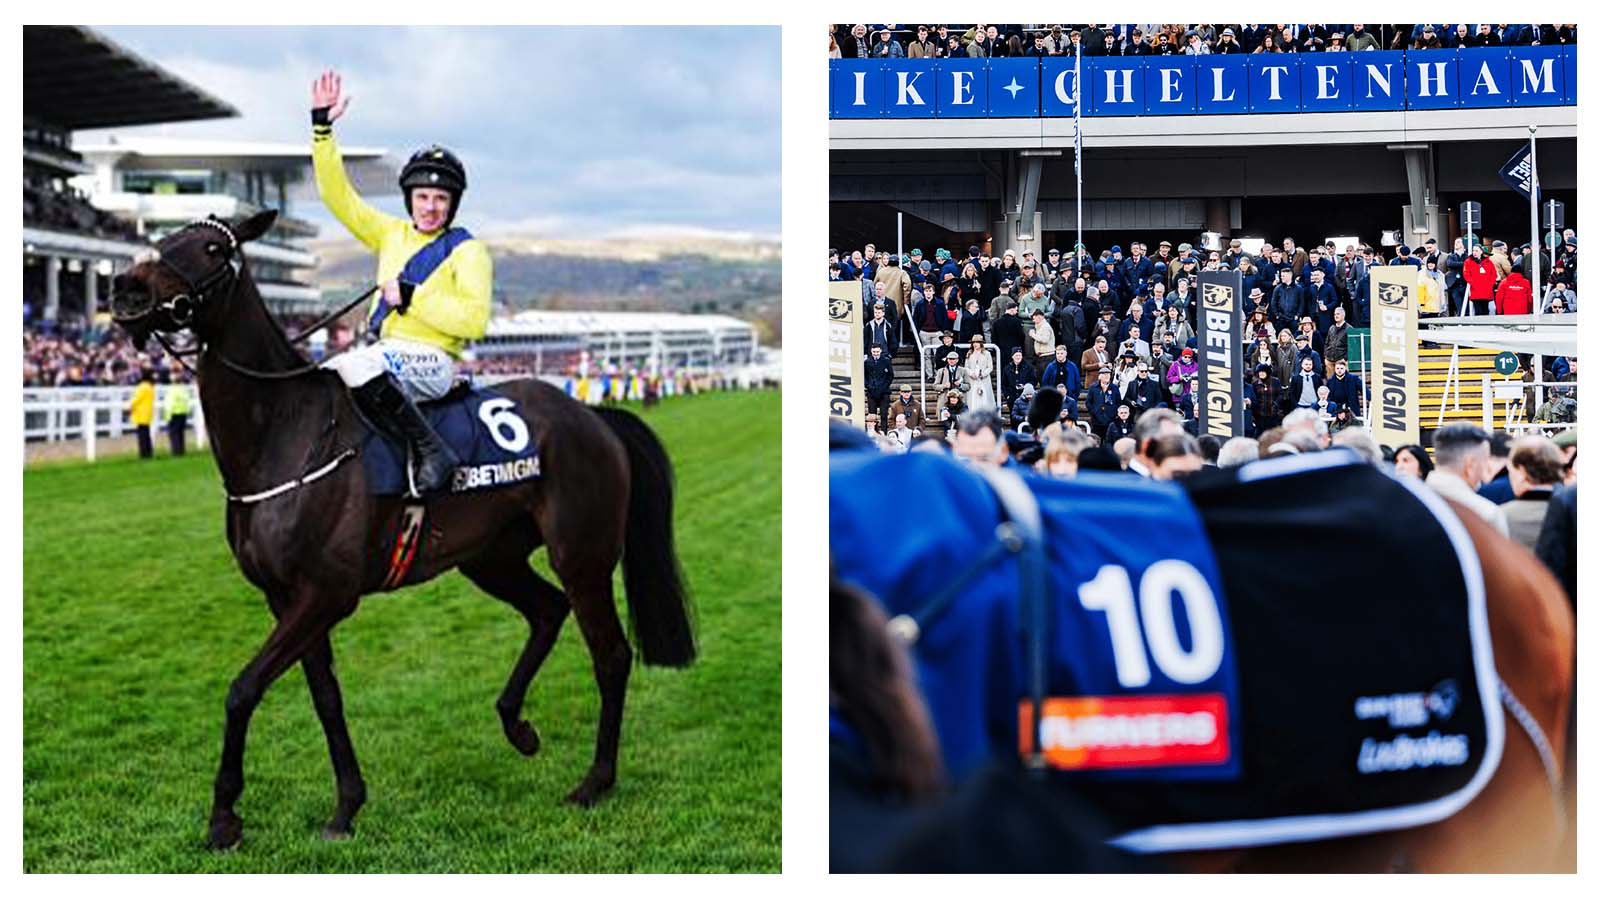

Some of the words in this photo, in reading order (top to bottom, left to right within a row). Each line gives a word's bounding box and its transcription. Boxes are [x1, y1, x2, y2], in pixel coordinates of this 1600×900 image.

[852, 71, 975, 106] IKE
[1054, 58, 1556, 105] CHELTENHAM
[1206, 310, 1232, 437] BETMGM
[1382, 309, 1407, 432] BETMGM
[1499, 357, 1514, 369] 1st
[478, 397, 529, 453] 6
[1077, 559, 1224, 688] 10
